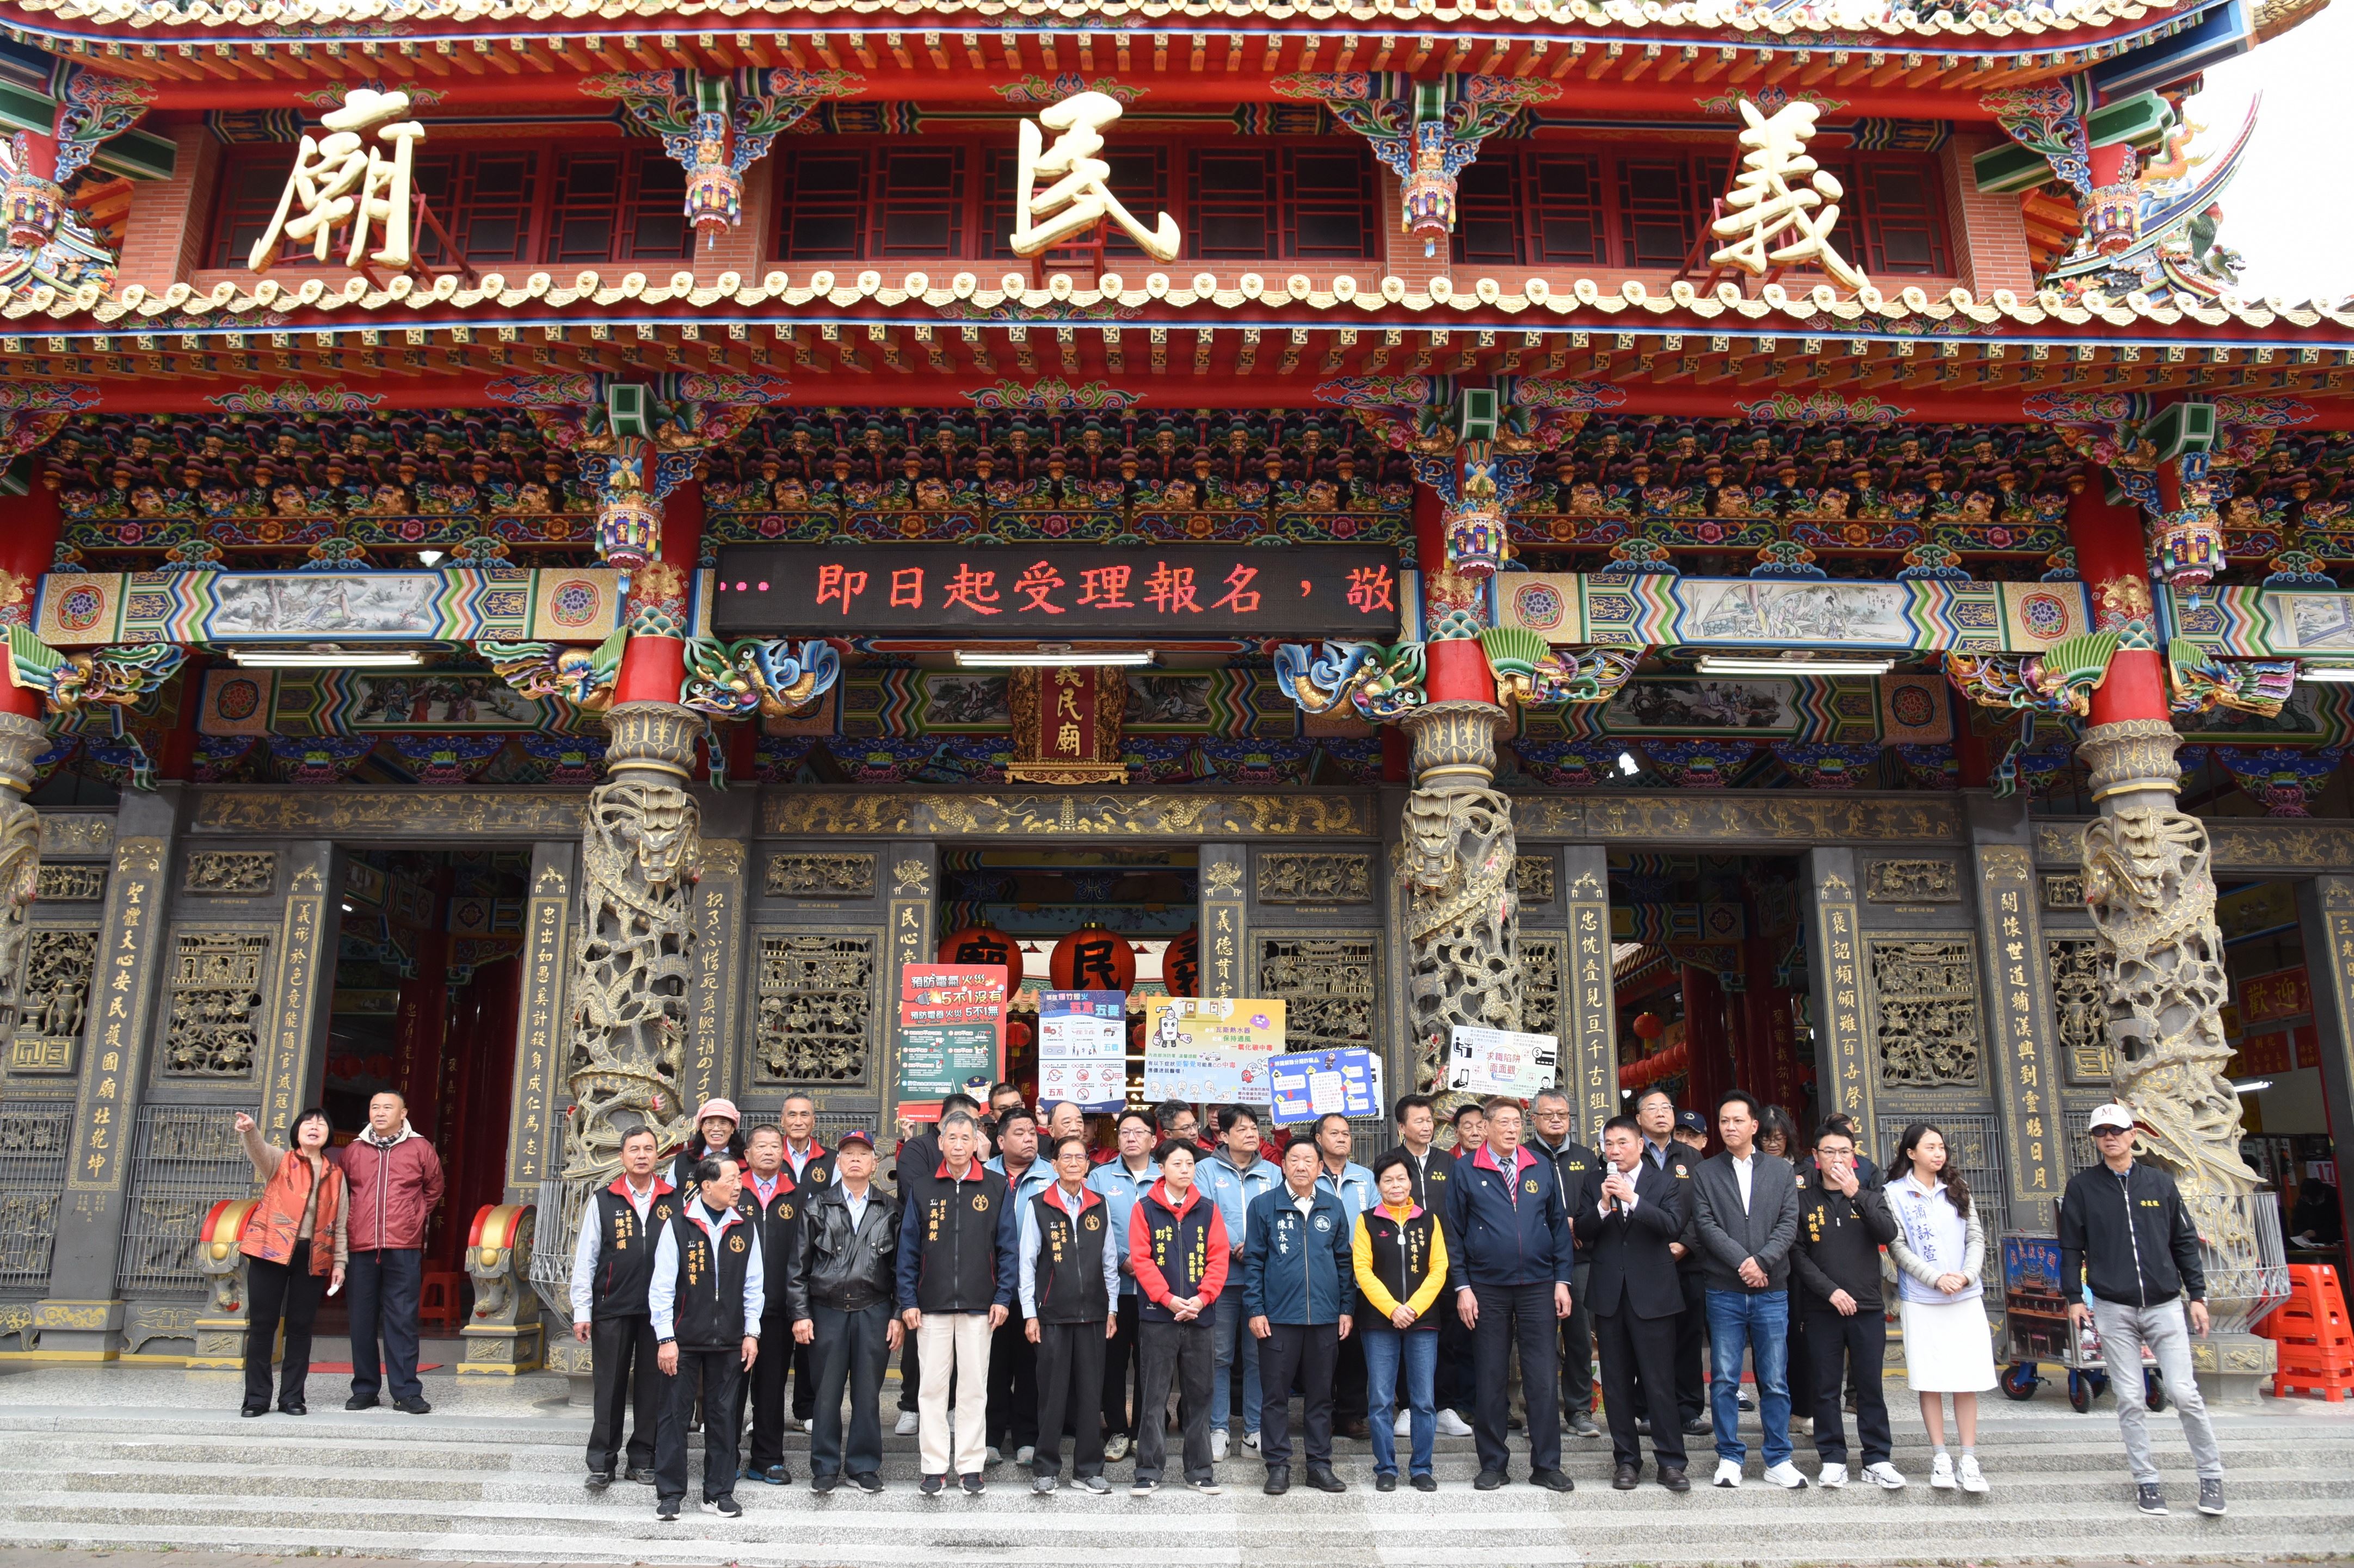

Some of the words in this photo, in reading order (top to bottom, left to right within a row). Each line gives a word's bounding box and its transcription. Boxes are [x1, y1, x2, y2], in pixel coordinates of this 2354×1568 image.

[1073, 941, 1121, 990] 民
[911, 974, 985, 988] 預防電氣火災
[941, 989, 1002, 1005] 5不1沒有
[965, 1005, 999, 1017] 5不1無
[1486, 1051, 1521, 1063] 求職陷阱
[1489, 1063, 1516, 1075] 面面觀
[2316, 1163, 2335, 1182] 17
[615, 1218, 627, 1250] 陳源順
[1277, 1220, 1289, 1255] 陳永賢
[1913, 1203, 1937, 1262] 蕭詠萱
